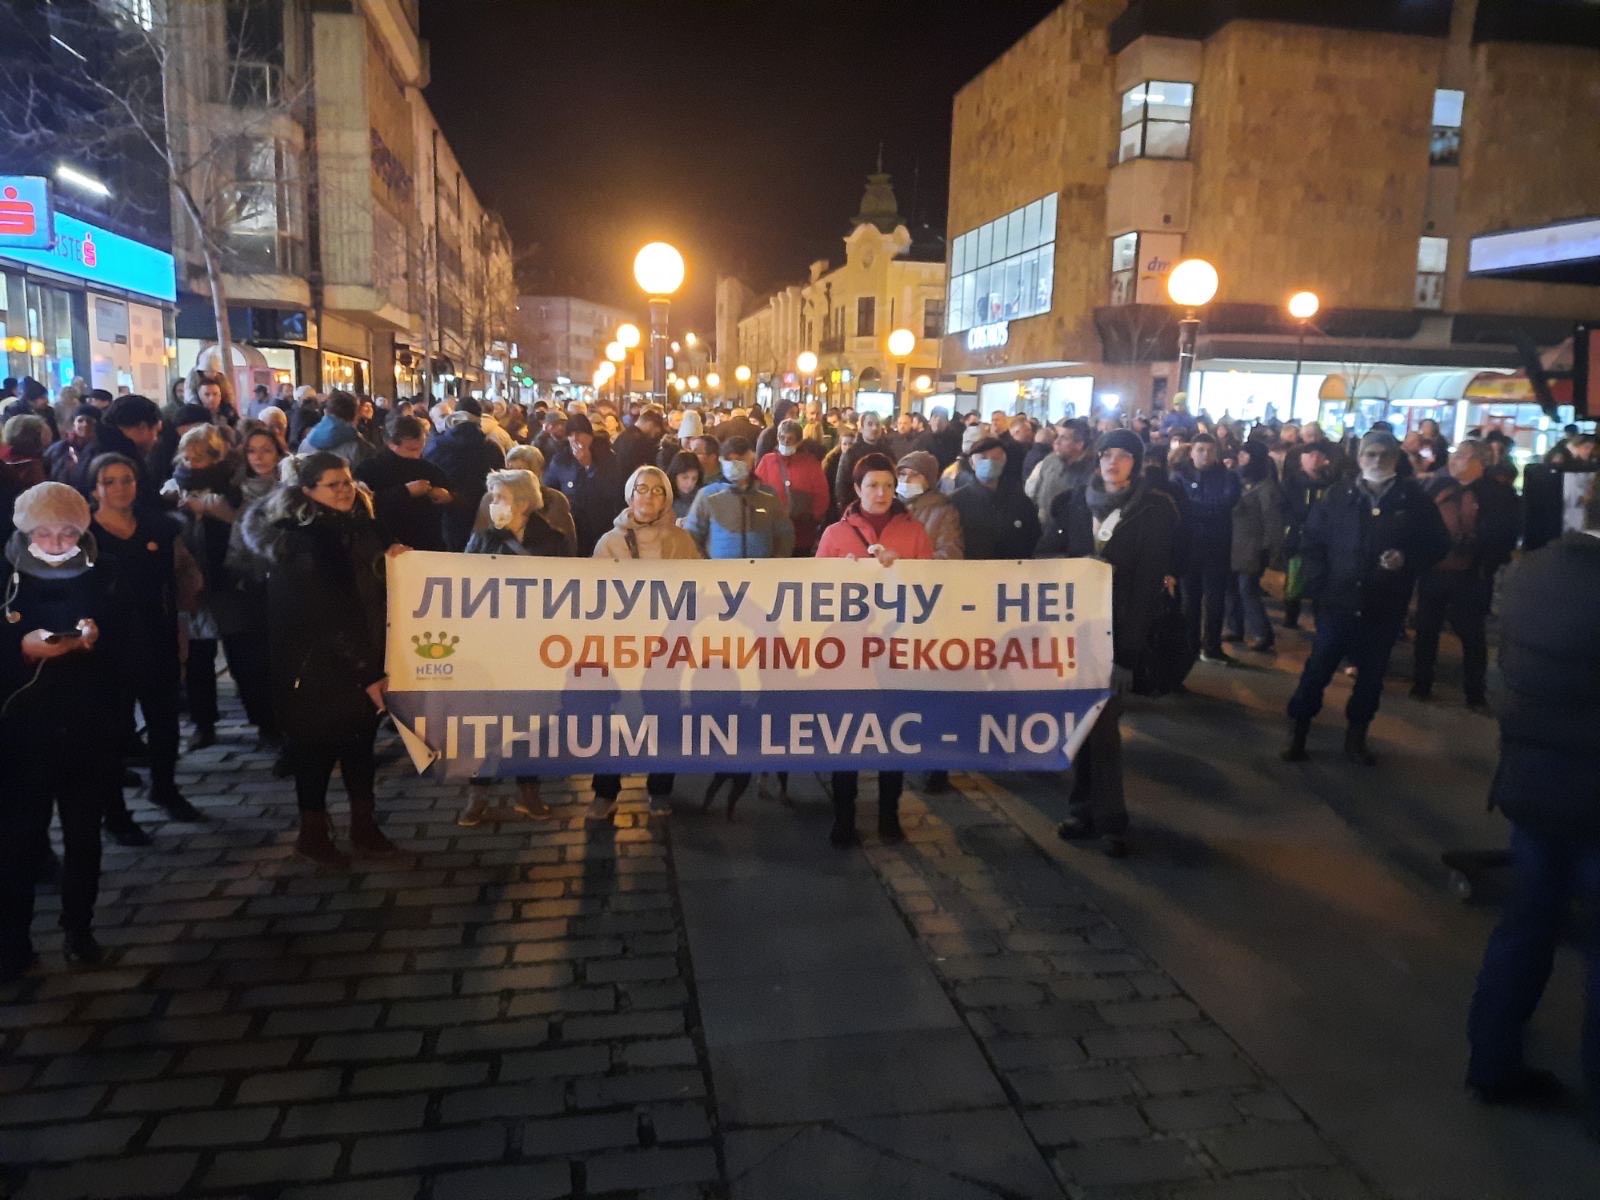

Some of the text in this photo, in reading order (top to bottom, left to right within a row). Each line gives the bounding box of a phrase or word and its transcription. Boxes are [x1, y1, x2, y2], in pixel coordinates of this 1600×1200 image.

[53, 232, 83, 262] RSTE
[412, 576, 1075, 625] ЛИТИЈУМ У ЛЕВЧУ - НЕ!
[539, 634, 1077, 678] ОДБРАНИМО РЕКОВАЦ!
[681, 714, 738, 756] IN
[760, 712, 923, 755] LEVAC
[941, 734, 958, 742] -
